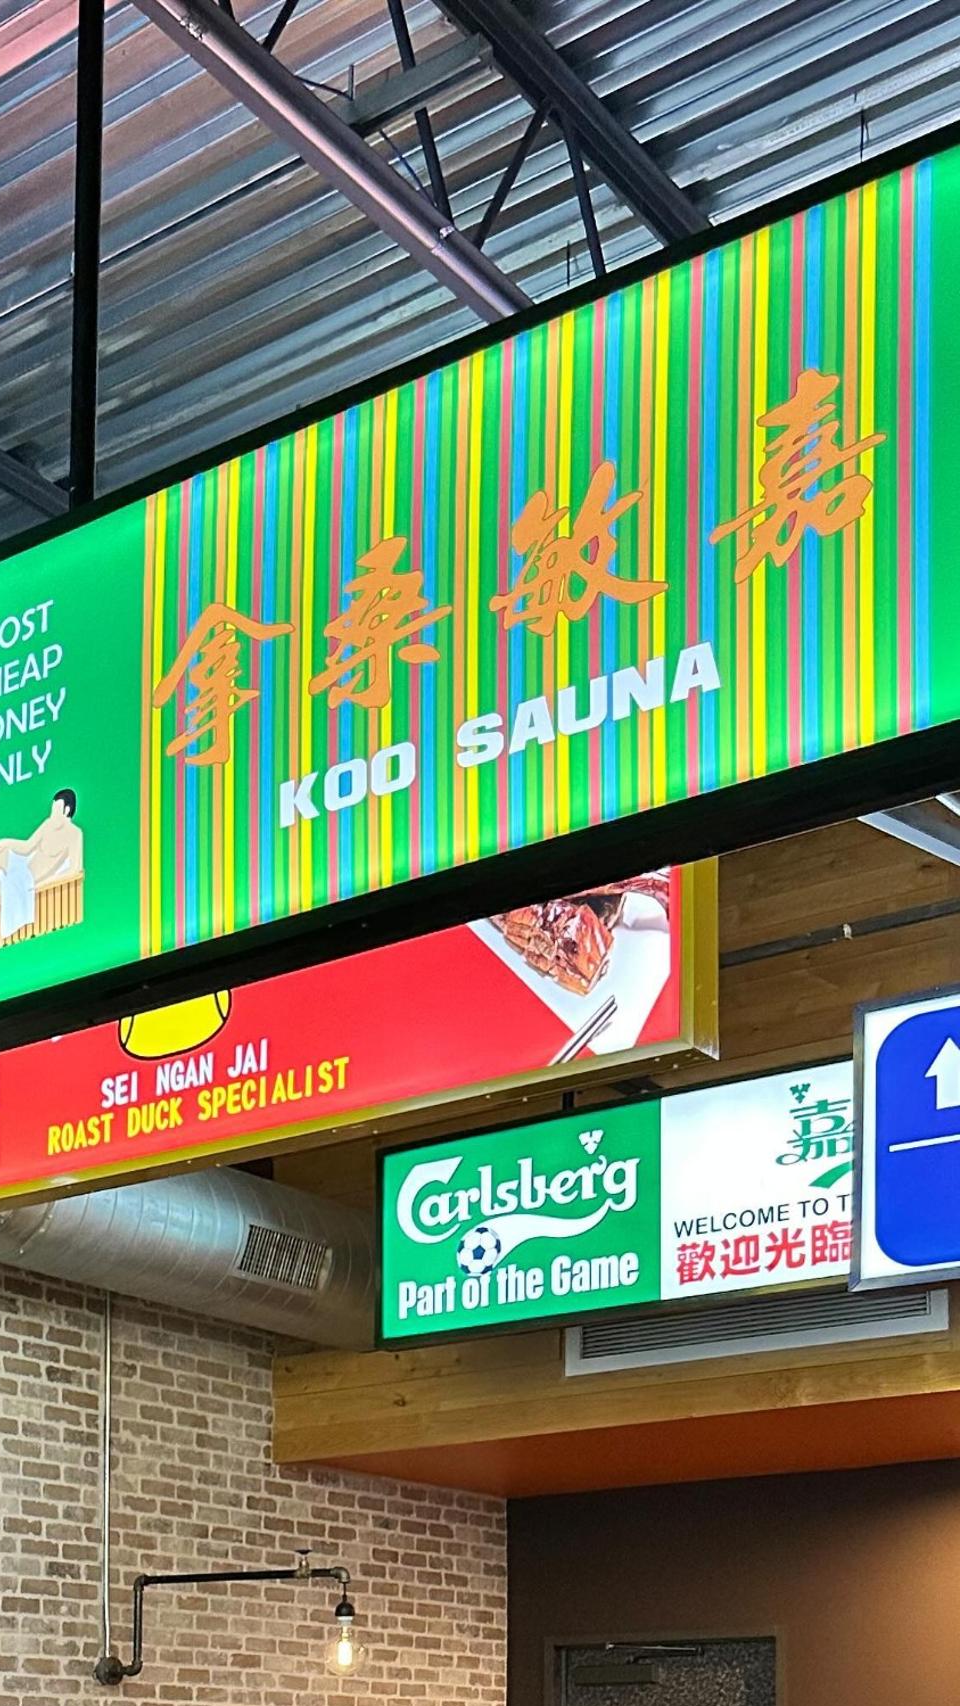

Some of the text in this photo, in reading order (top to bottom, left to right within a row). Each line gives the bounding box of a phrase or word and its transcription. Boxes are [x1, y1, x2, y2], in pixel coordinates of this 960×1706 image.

[279, 641, 721, 828] KOO SAUNA
[48, 1056, 349, 1155] ROAST DUCK SPECIALIST
[101, 1038, 268, 1108] SEI NGAN JAI
[397, 1156, 640, 1244] Carlsberg
[674, 1203, 790, 1238] WELCOME
[797, 1198, 829, 1218] TO
[398, 1252, 639, 1320] Part of the Game
